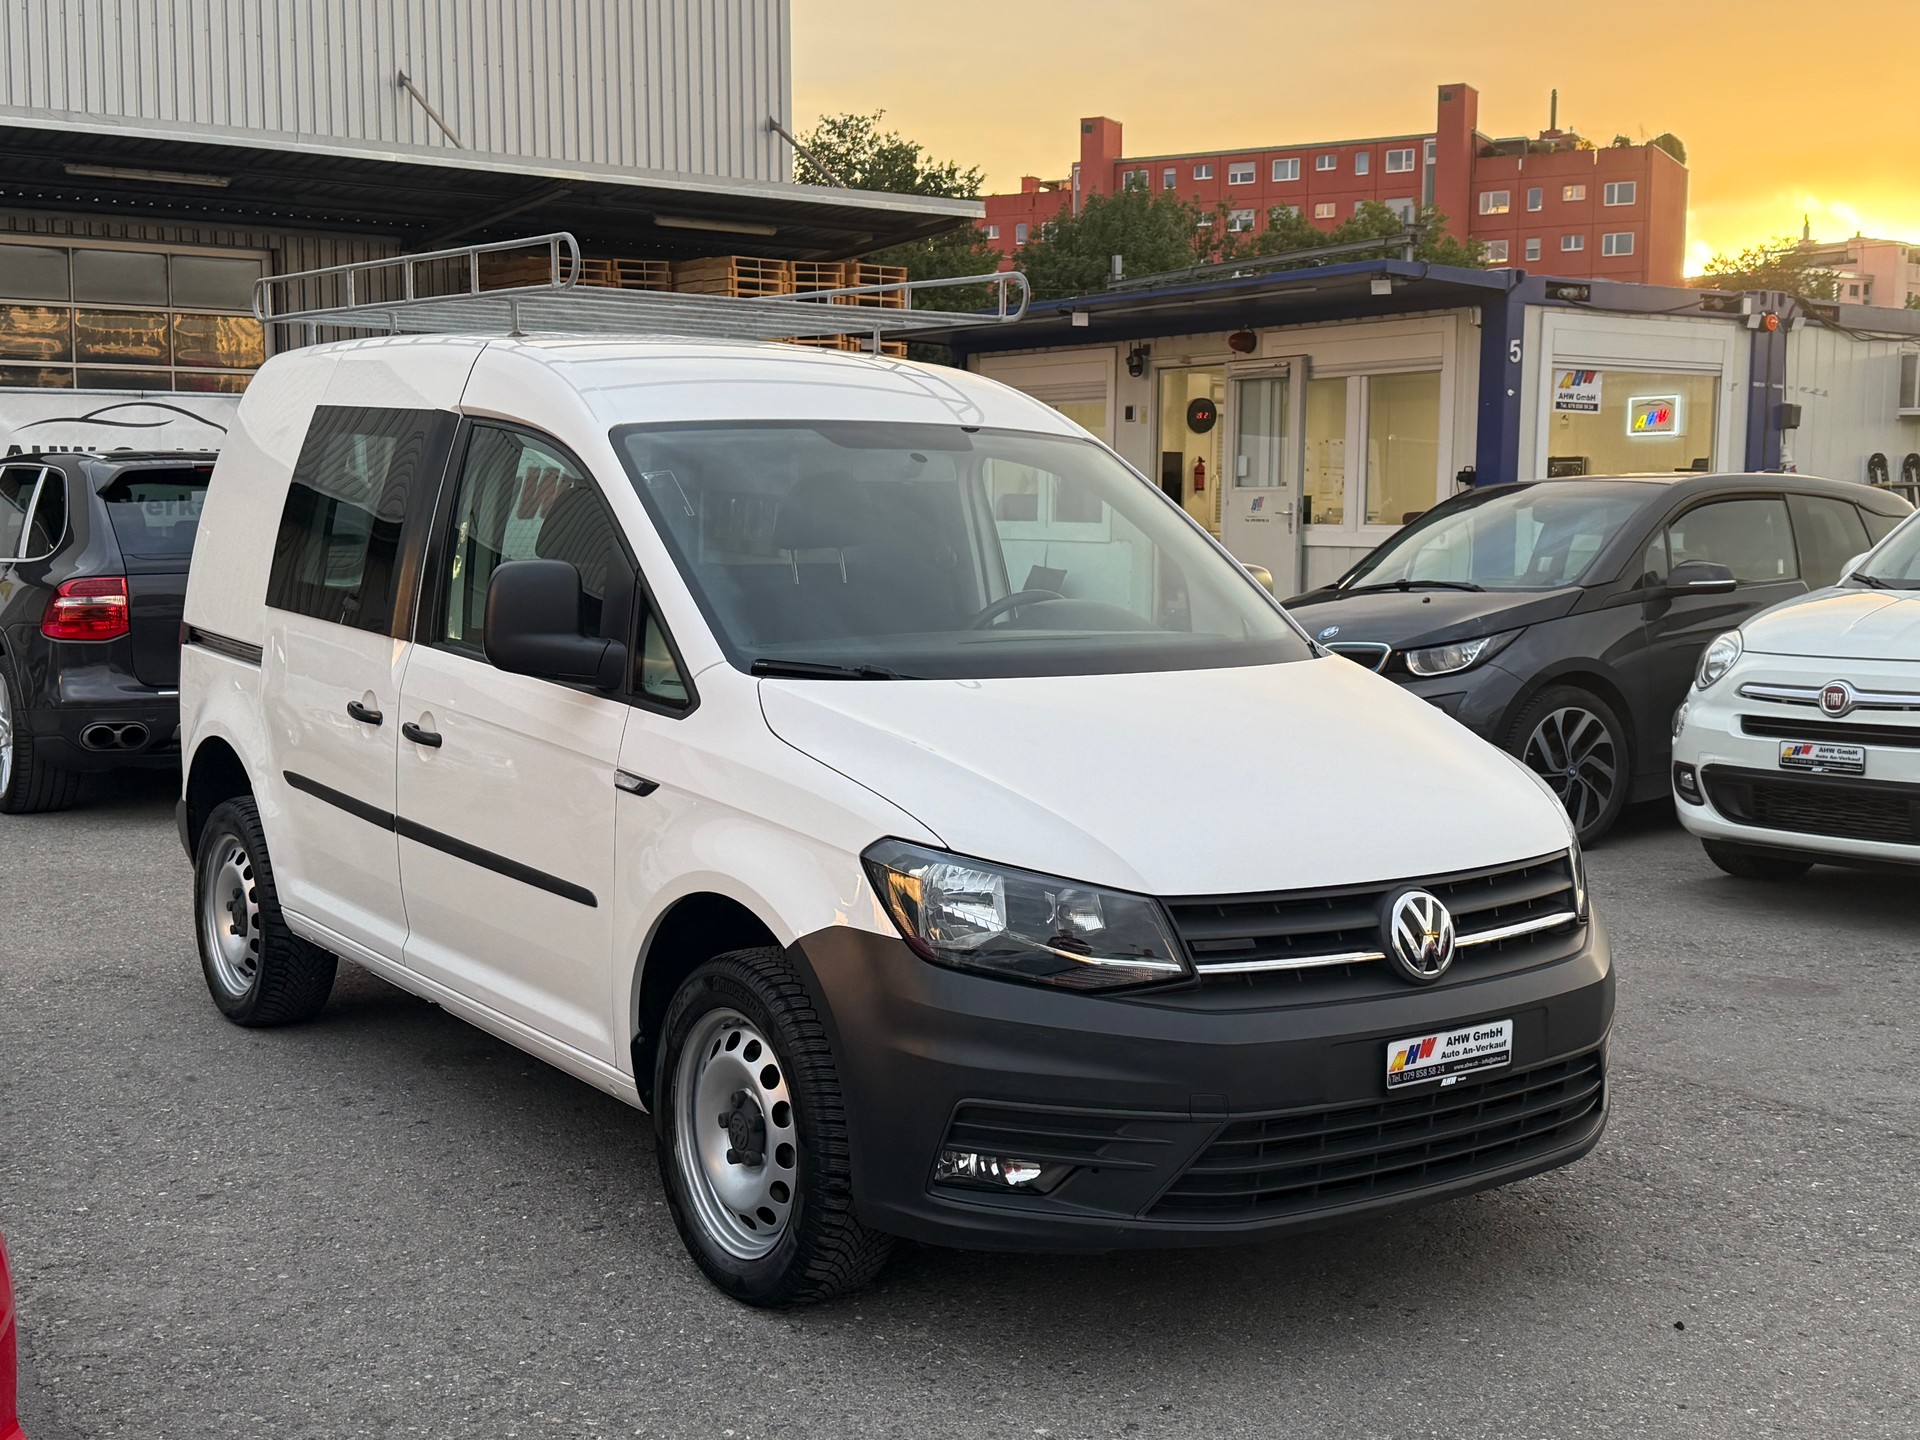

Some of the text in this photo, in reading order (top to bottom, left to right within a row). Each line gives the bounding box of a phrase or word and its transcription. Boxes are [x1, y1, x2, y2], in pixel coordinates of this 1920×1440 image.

[1509, 339, 1522, 363] 5
[1558, 369, 1597, 389] AHW
[1558, 392, 1596, 401] AHW GmbH
[1634, 408, 1671, 429] AHW
[1827, 692, 1843, 706] FIAT
[1782, 743, 1813, 757] AHW
[1837, 748, 1858, 756] GmbH
[1446, 1027, 1503, 1047] AHW GmbH
[1389, 1037, 1438, 1072] AHW
[1441, 1039, 1507, 1059] Auto An-Verkauf
[1391, 1064, 1445, 1083] Tel. 079 858 58 24
